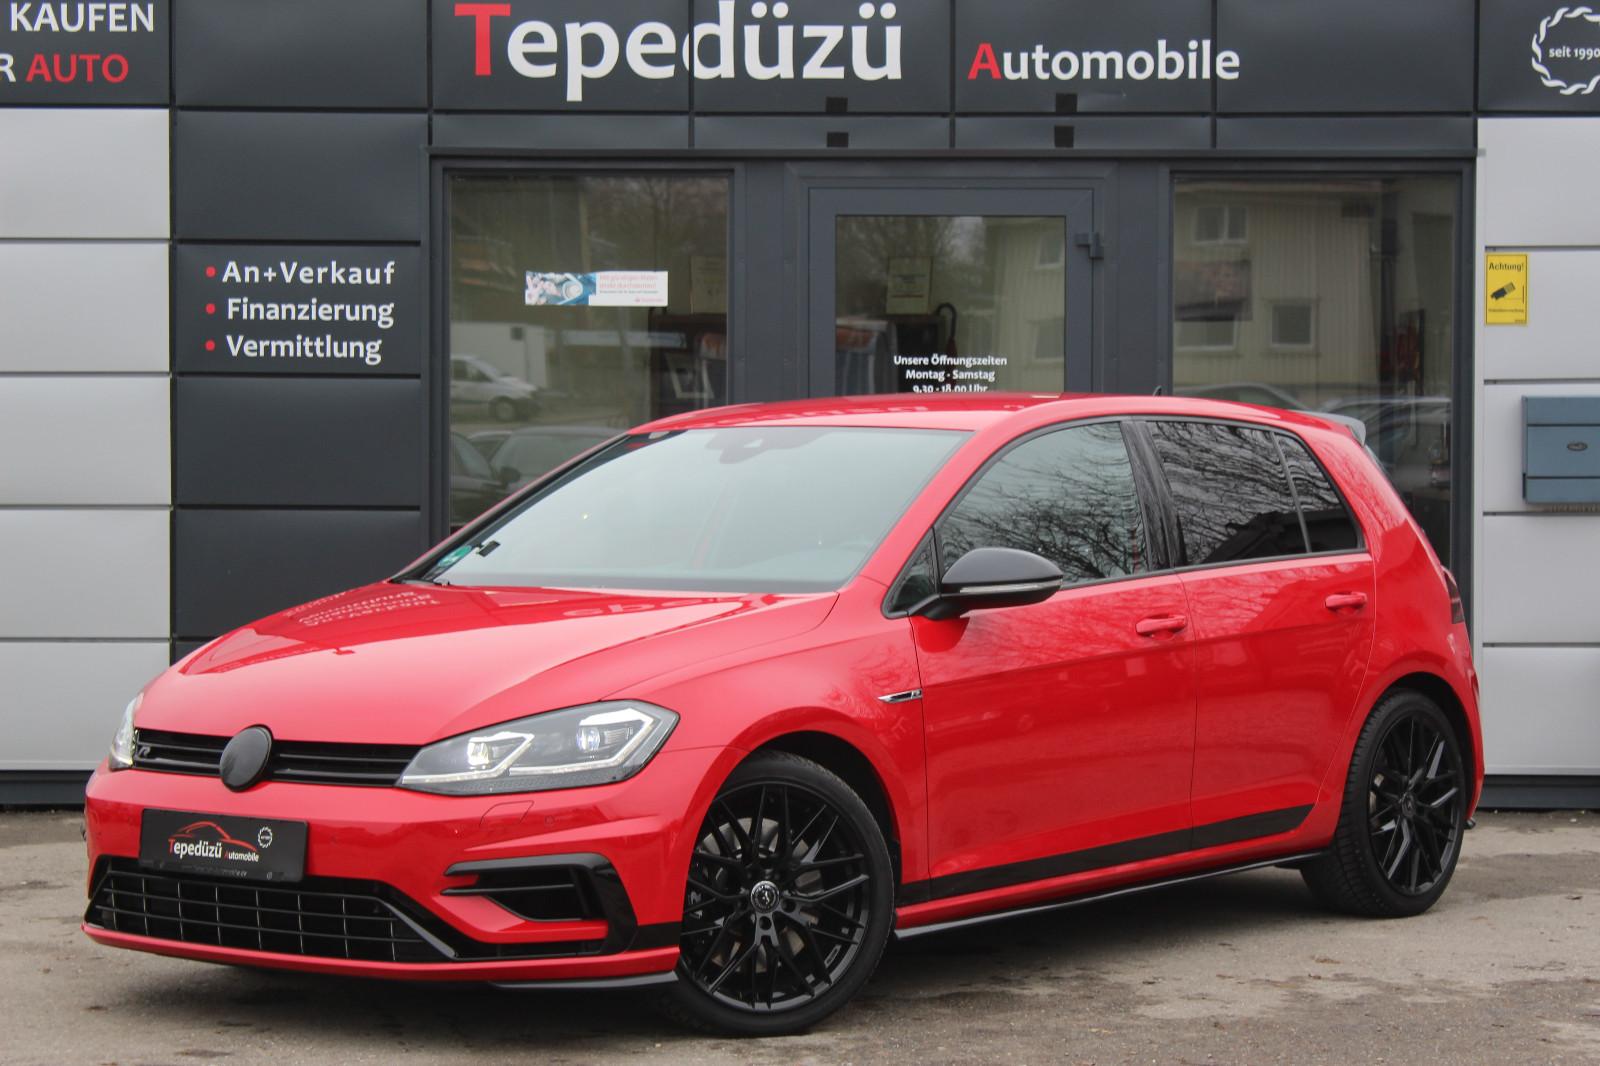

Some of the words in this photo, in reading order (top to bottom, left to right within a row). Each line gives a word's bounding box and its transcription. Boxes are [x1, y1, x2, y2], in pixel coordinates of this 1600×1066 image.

[10, 2, 154, 33] KAUFEN
[454, 0, 902, 102] Tepedüzü
[967, 39, 1241, 81] Automobile
[1548, 46, 1571, 58] seit
[1574, 48, 1600, 60] 1990
[26, 53, 129, 84] AUTO
[221, 260, 396, 285] An+Verkauf
[227, 297, 396, 329] Finanzierung
[225, 334, 383, 366] Vermittlung
[893, 355, 930, 366] Unsere
[931, 353, 1008, 368] Öffnungszeiten
[905, 369, 946, 382] Montag
[952, 369, 996, 382] Samstag
[168, 837, 223, 860] Tepedüzü
[223, 850, 261, 863] Automobile
